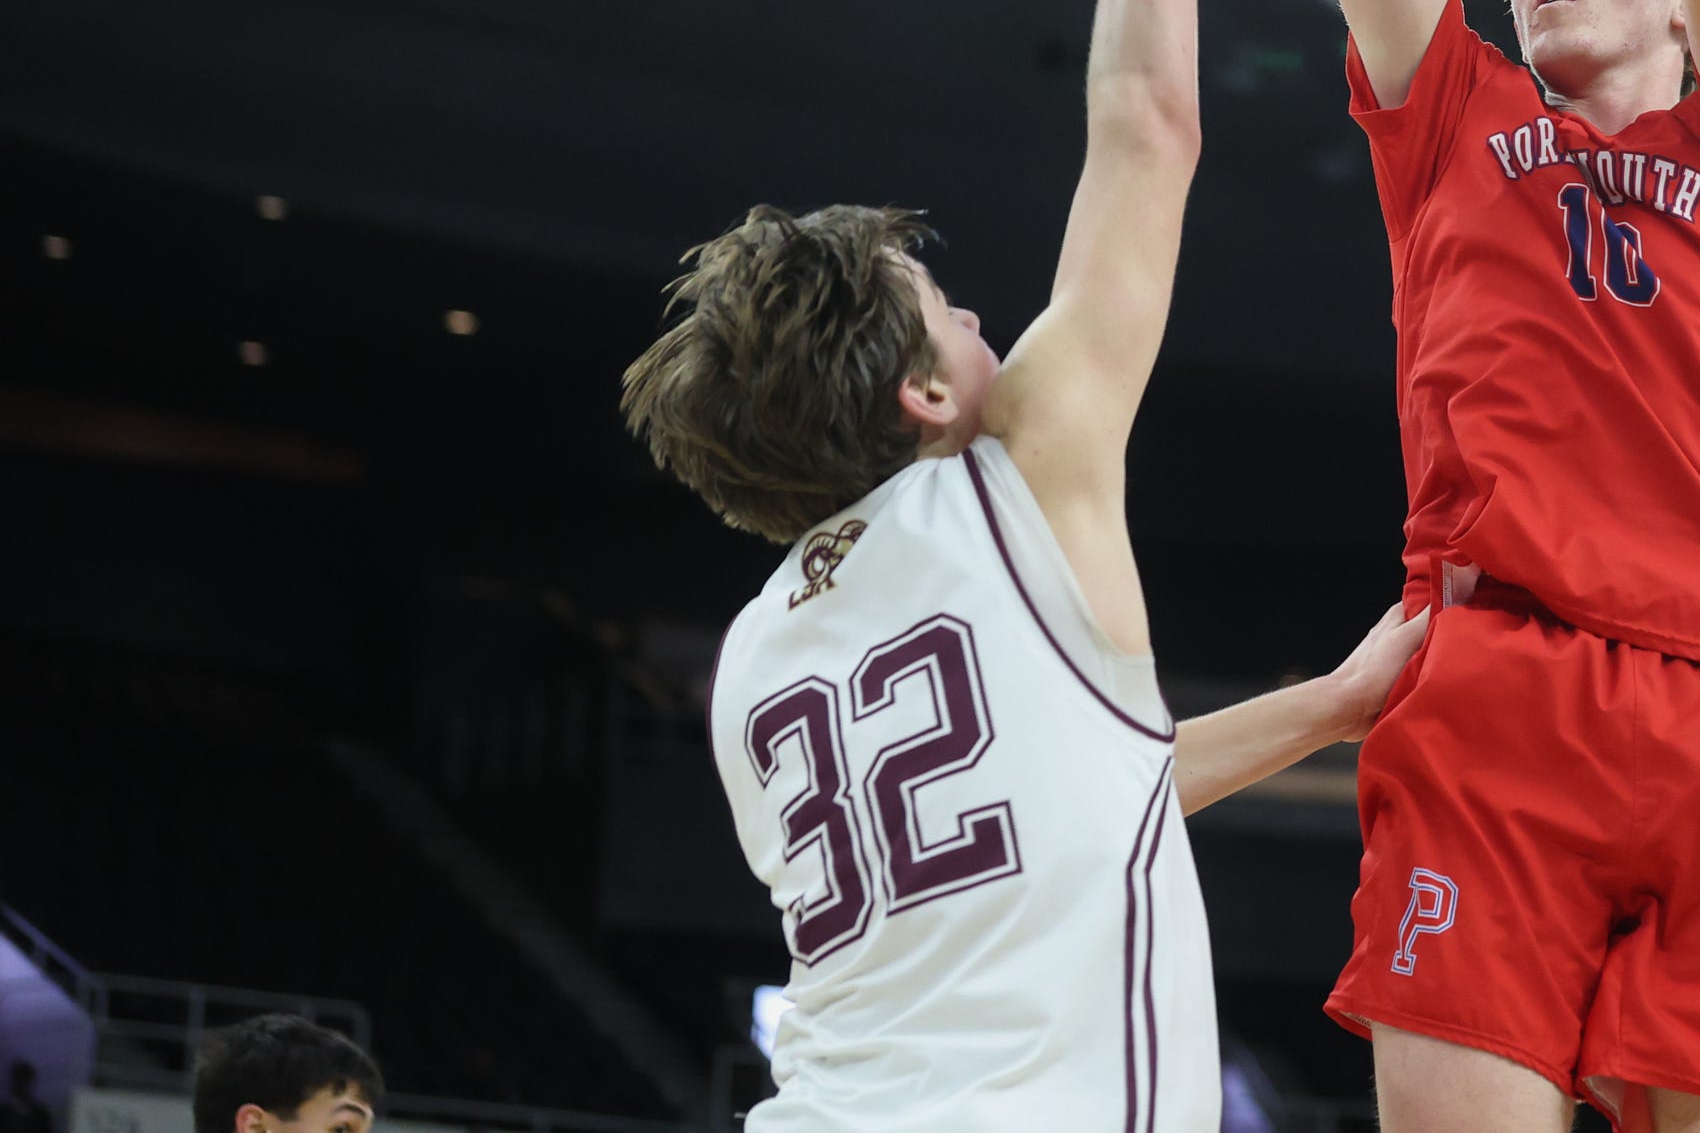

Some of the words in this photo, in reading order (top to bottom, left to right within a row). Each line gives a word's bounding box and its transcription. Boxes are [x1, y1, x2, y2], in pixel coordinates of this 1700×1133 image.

[1557, 182, 1661, 307] 10
[744, 611, 1023, 969] 32
[1390, 866, 1460, 977] P
